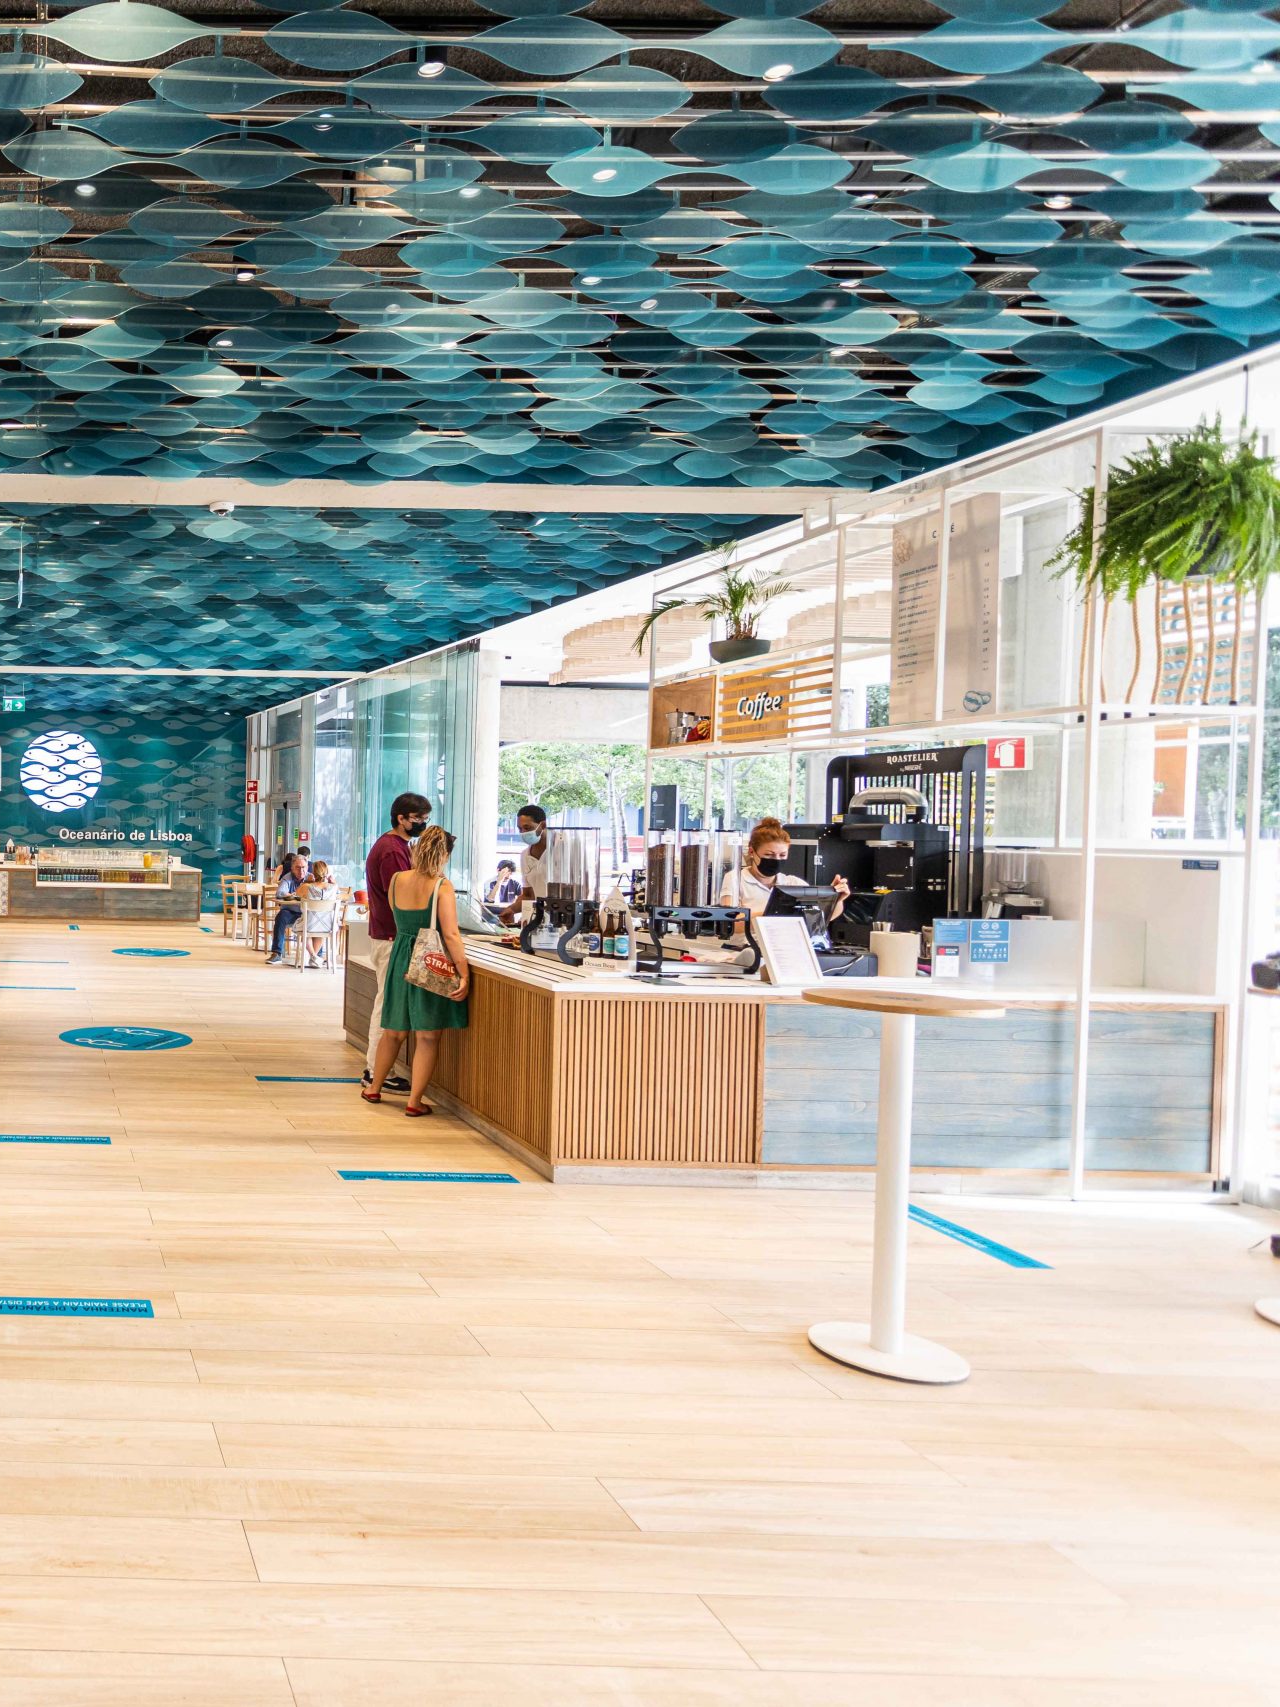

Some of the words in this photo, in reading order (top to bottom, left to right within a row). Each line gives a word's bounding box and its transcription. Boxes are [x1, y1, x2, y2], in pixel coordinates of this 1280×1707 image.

[737, 692, 783, 721] Coffee
[887, 752, 938, 765] ROASTELIER
[59, 828, 126, 841] Oceanário
[129, 829, 146, 841] de
[150, 829, 193, 842] Lisboa
[7, 1303, 67, 1311] DISTÂNCIA
